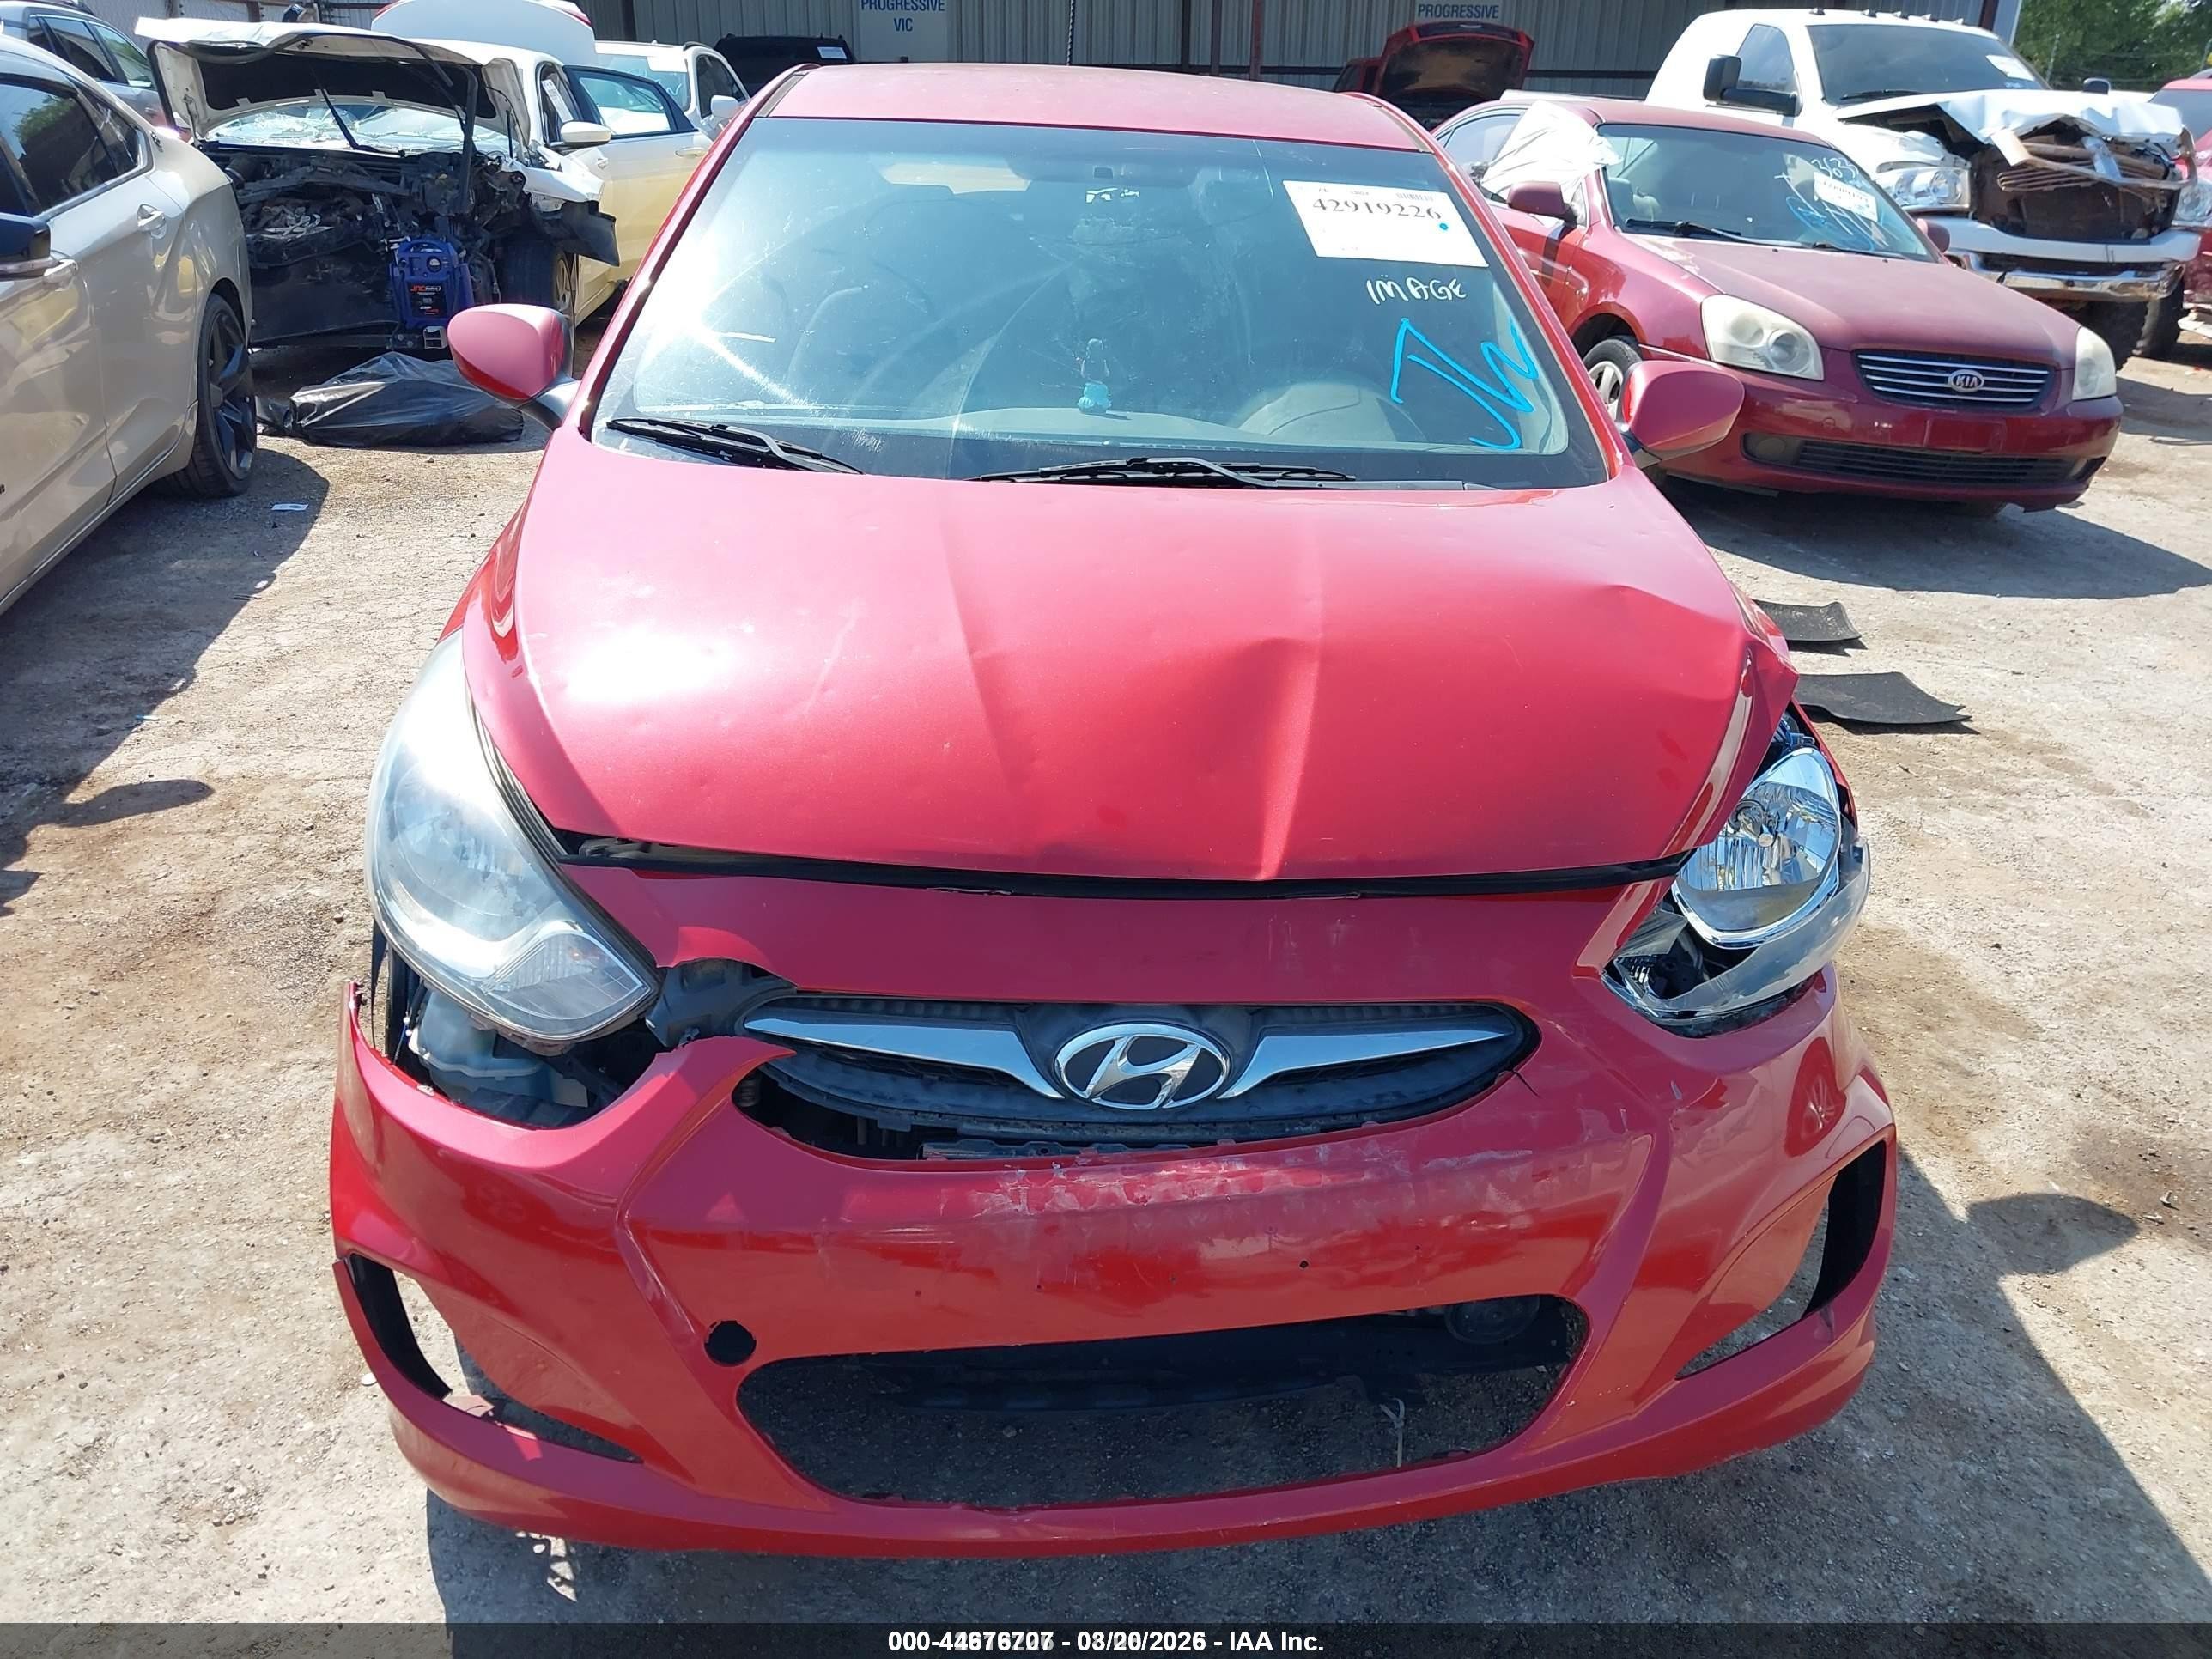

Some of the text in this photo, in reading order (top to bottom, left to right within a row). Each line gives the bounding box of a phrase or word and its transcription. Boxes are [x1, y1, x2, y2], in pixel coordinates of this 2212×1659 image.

[860, 0, 946, 11] PROGRESSIVE
[1418, 3, 1499, 19] PROGRESSIVE
[893, 17, 914, 32] VIC
[1312, 198, 1443, 220] 42919226
[1366, 276, 1468, 305] IMAGE
[1955, 374, 1979, 388] KIA
